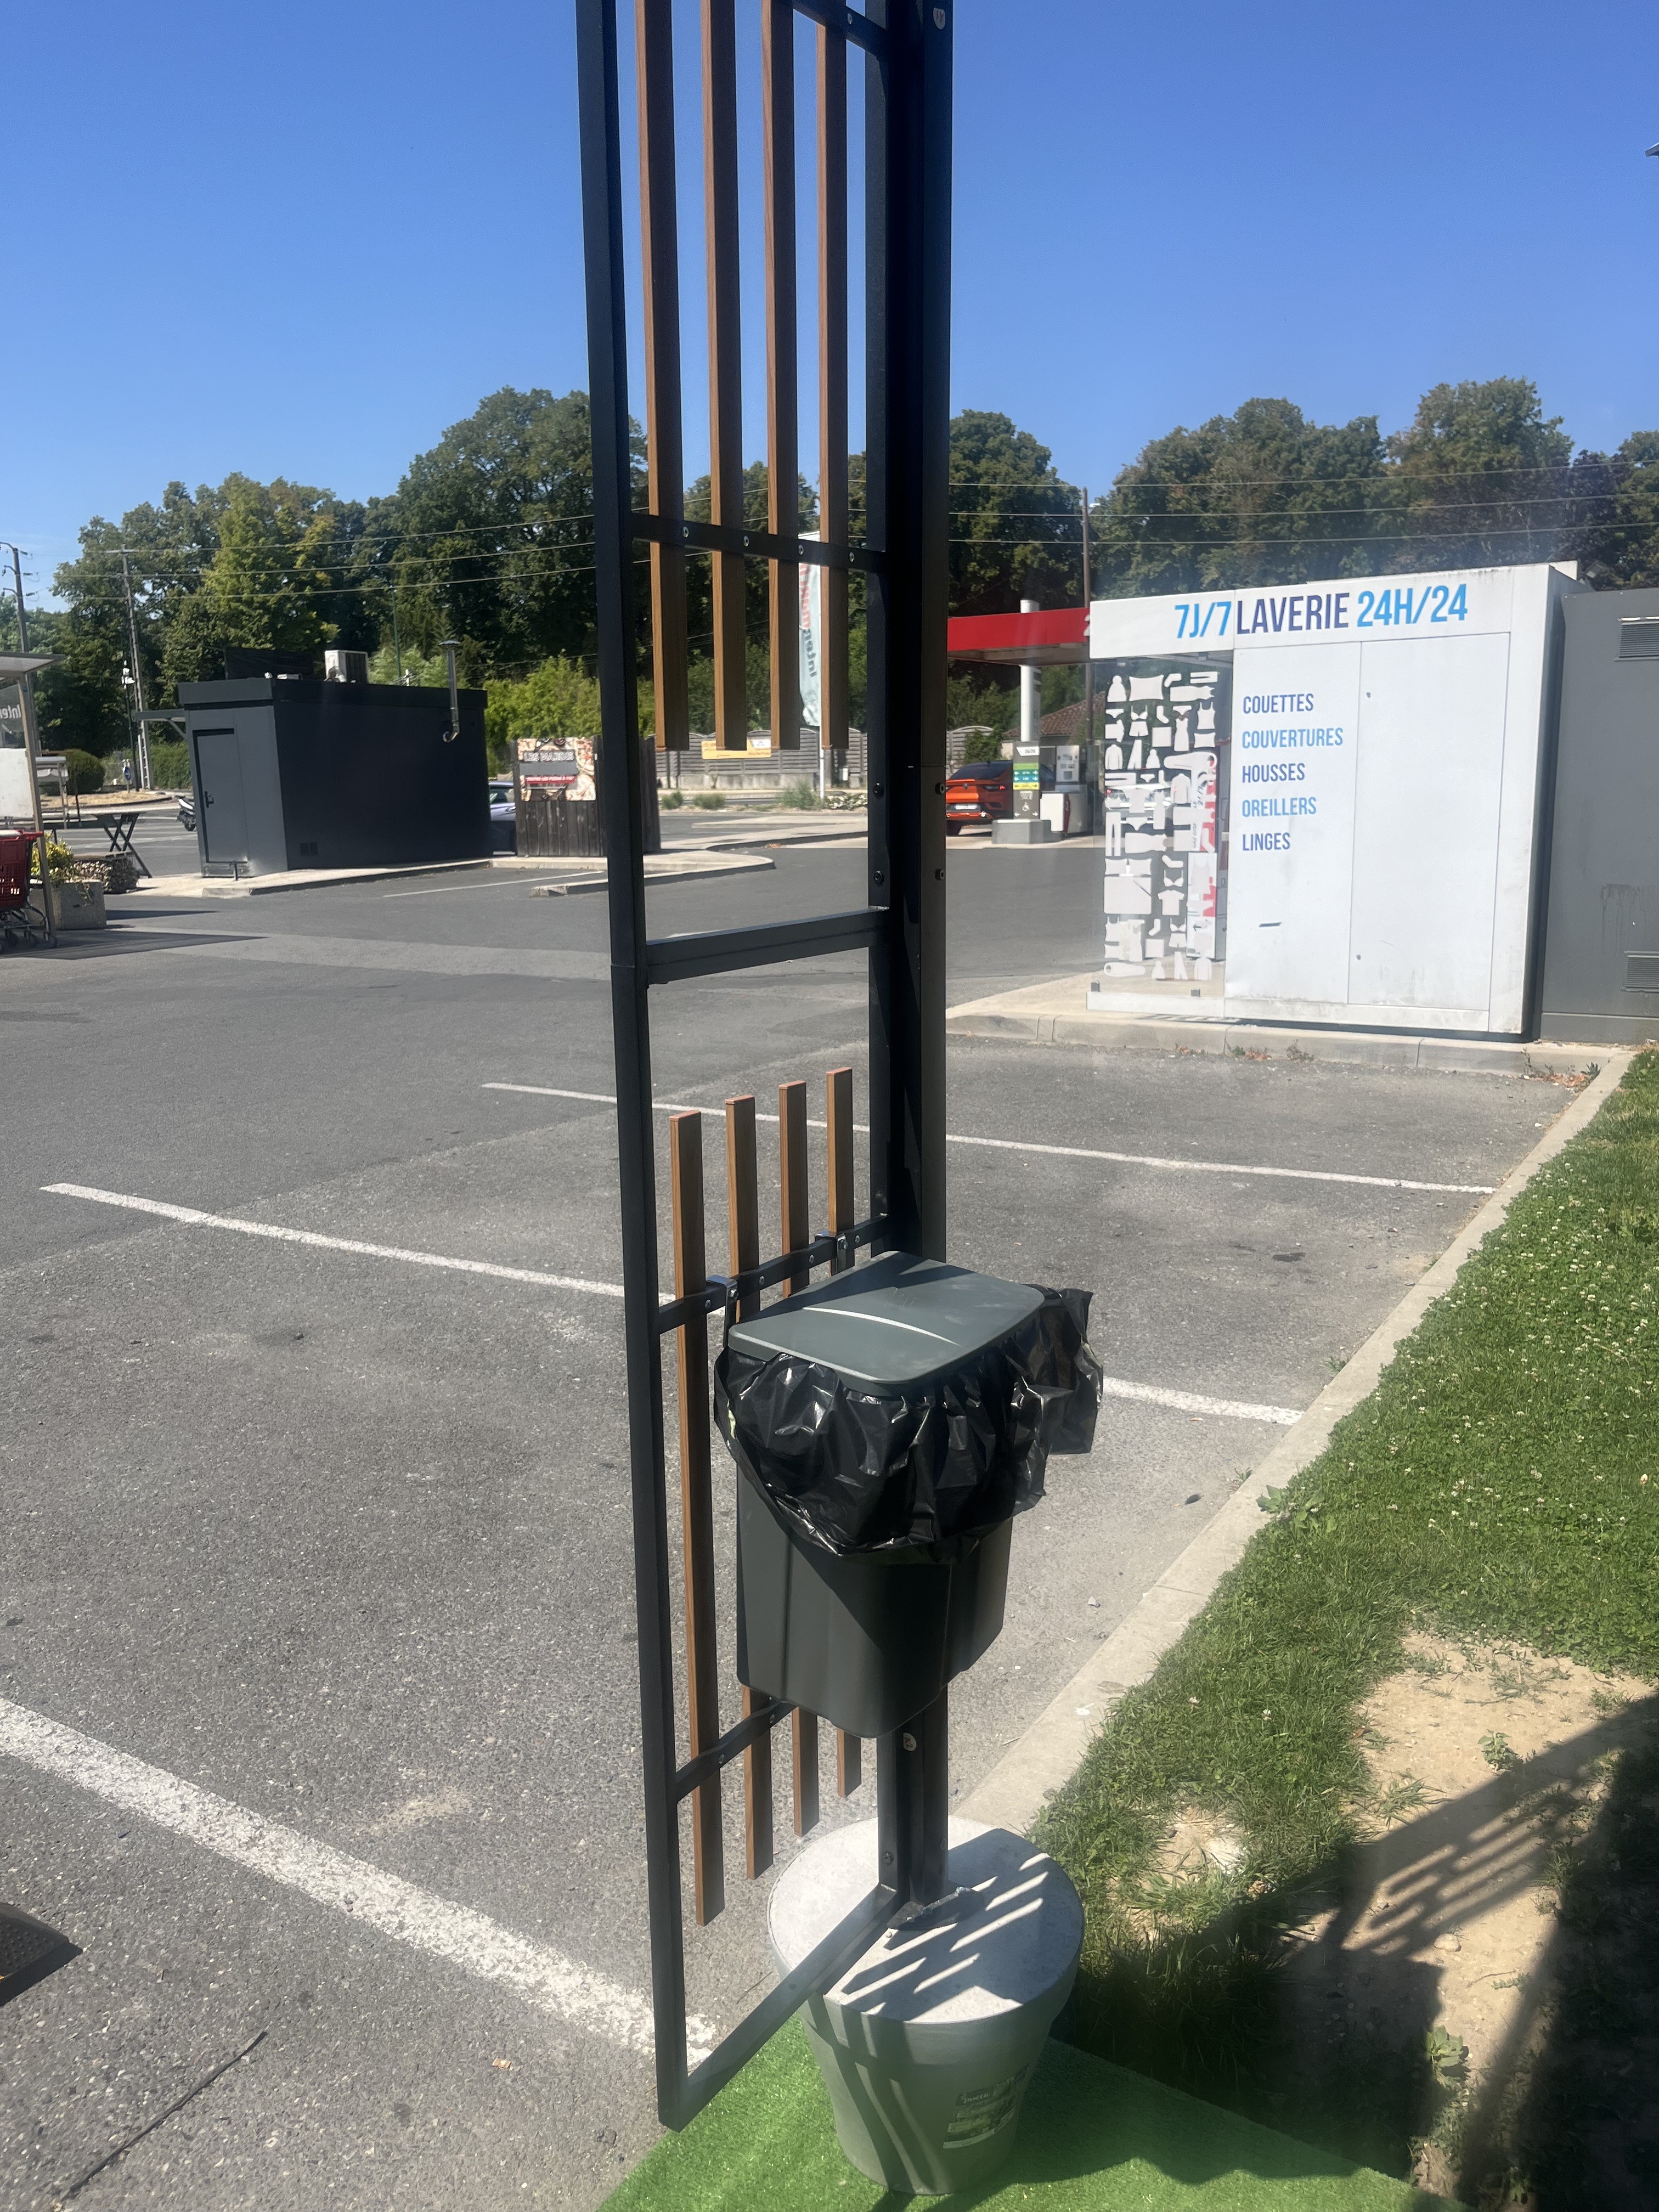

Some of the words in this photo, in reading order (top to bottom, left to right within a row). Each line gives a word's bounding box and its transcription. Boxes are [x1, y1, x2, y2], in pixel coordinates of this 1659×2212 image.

[1175, 601, 1232, 639] 7J/7
[1237, 592, 1350, 635] LAVERIE
[1357, 583, 1468, 628] 24H/24
[1243, 693, 1314, 714] COUETTES
[1242, 727, 1344, 749] COUVERTURES
[1242, 763, 1306, 783] HOUSSES
[1242, 797, 1317, 817] OREILLERS
[1242, 832, 1291, 851] LINGES
